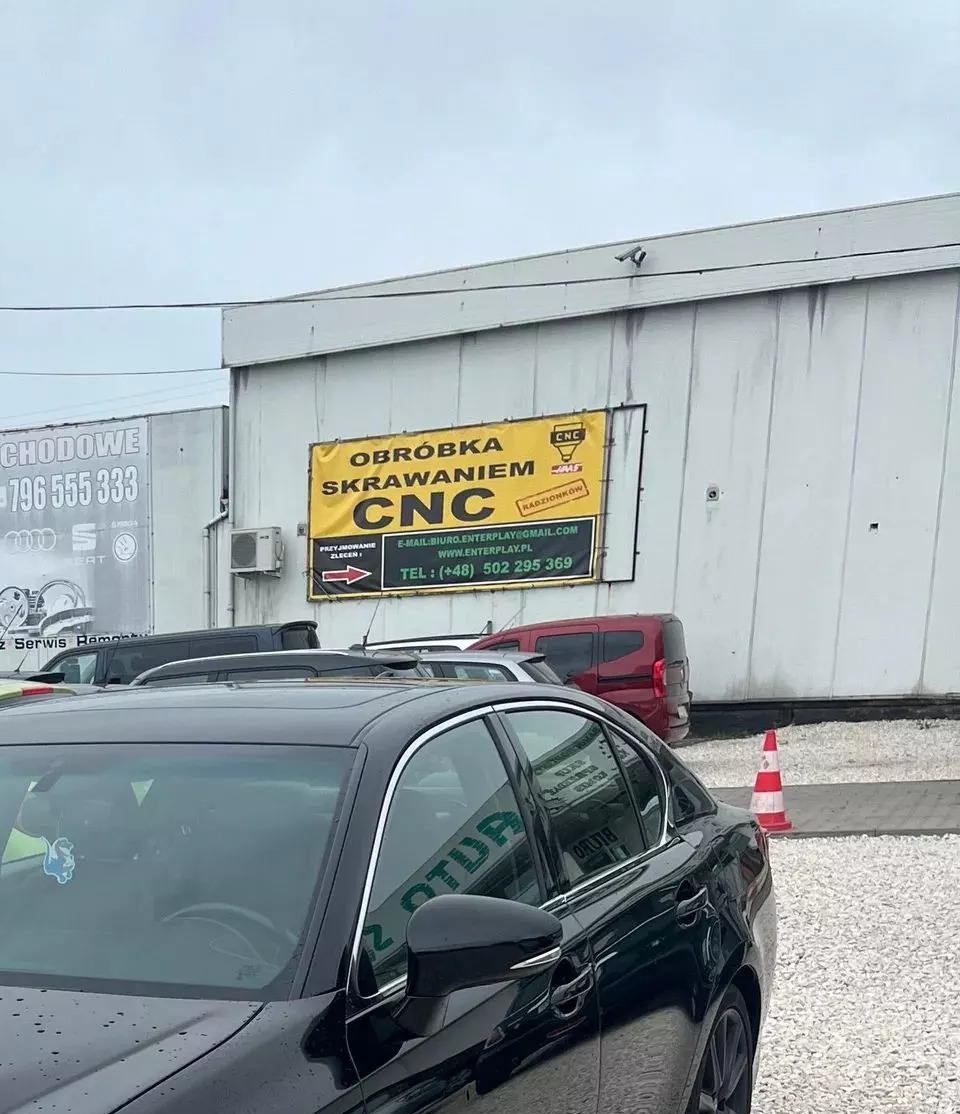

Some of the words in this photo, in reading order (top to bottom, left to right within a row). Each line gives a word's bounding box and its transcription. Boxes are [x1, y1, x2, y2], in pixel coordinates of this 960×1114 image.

[556, 431, 580, 441] CNC
[350, 438, 503, 467] OBRÓBKA
[9, 475, 47, 512] 796
[50, 471, 91, 509] 555
[97, 465, 139, 504] 333
[322, 461, 535, 495] SKRAWANIEM
[353, 488, 495, 529] CNC
[523, 485, 583, 511] RADZIONKÓW
[319, 542, 376, 553] PRZYJMOWANIE
[438, 544, 532, 559] WWW.ENTERPLAY.PL
[400, 568, 426, 580] TEL
[440, 564, 474, 581] (+48)
[483, 562, 509, 575] 502
[514, 559, 540, 572] 295
[545, 557, 573, 570] 369
[15, 637, 67, 649] Serwis
